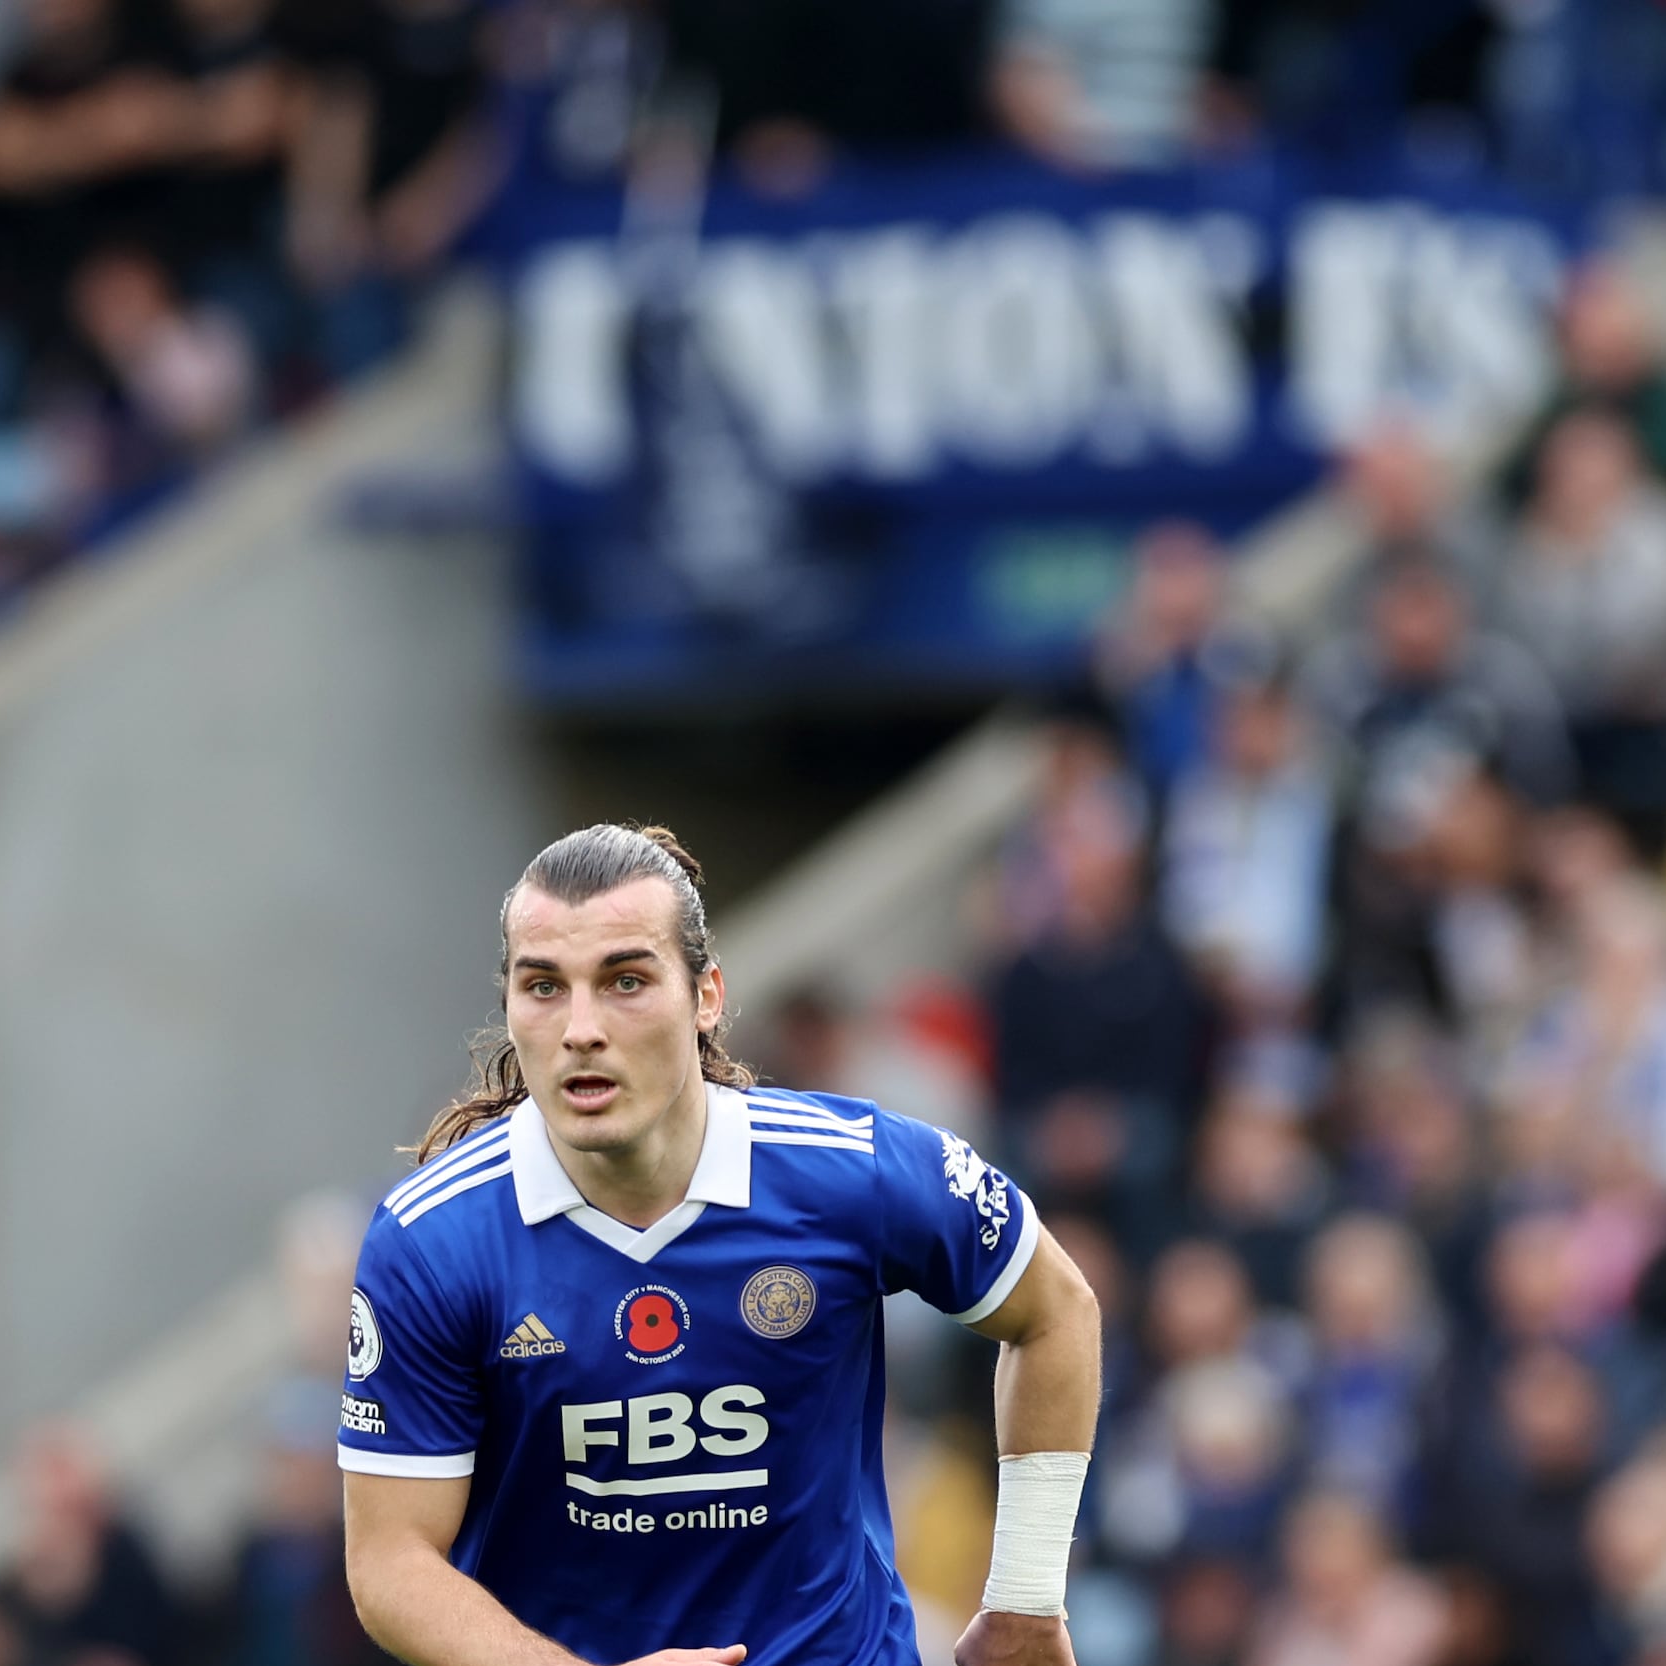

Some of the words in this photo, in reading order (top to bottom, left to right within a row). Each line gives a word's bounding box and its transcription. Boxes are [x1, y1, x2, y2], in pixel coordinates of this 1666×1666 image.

[982, 1164, 1010, 1251] SAIGO
[748, 1272, 793, 1303] LEICESTER
[793, 1277, 809, 1295] CITY
[614, 1299, 627, 1340] LEICESTER
[625, 1287, 640, 1301] CITY
[646, 1284, 688, 1313] MANCHESTER
[683, 1313, 691, 1330] CITY
[748, 1309, 793, 1332] FOOTBALL
[793, 1300, 809, 1324] CLUB
[500, 1340, 566, 1358] adidas
[638, 1353, 672, 1365] OCTOBER
[346, 1396, 379, 1418] room
[342, 1411, 386, 1435] racism
[561, 1384, 769, 1465] FBS
[566, 1500, 656, 1534] trade
[664, 1502, 768, 1529] online
